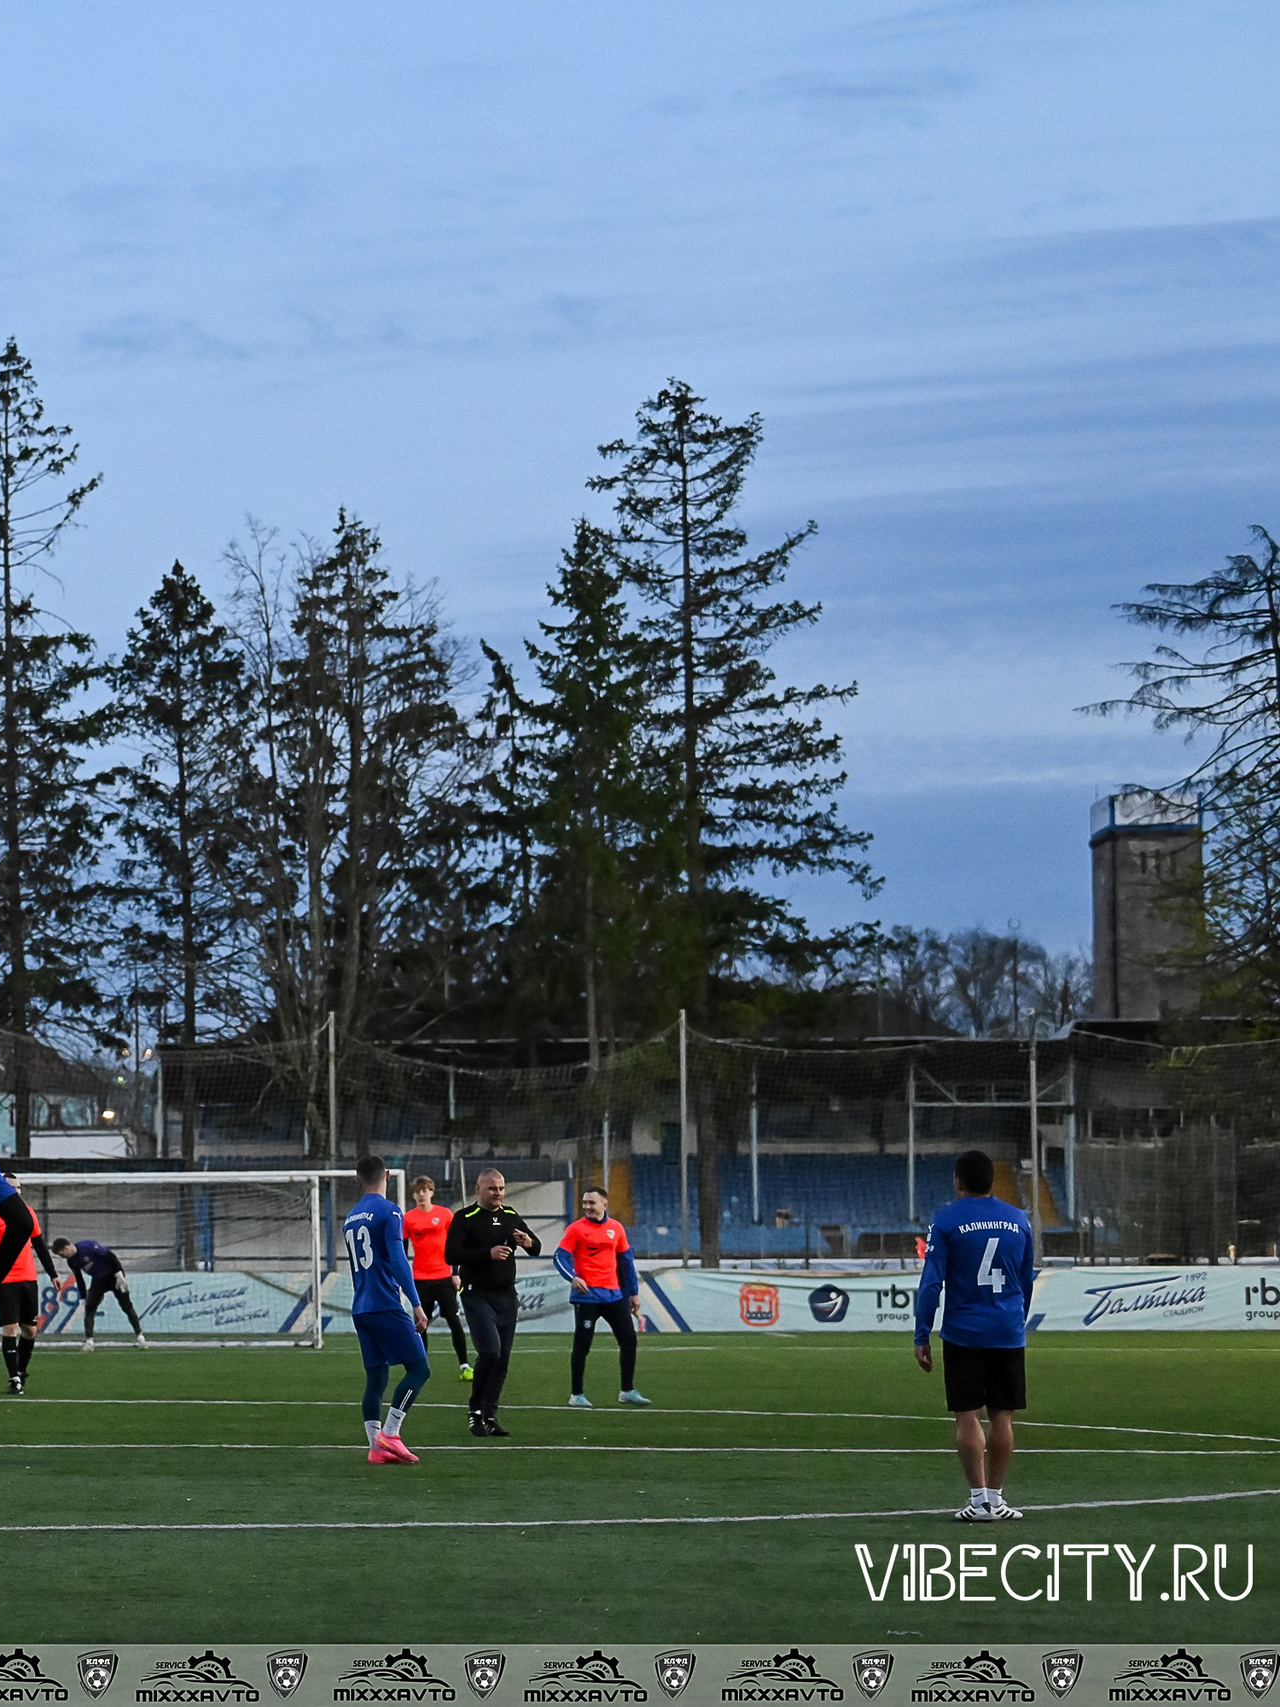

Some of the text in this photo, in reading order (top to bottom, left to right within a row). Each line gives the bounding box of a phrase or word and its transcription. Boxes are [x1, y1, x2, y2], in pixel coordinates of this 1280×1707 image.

[959, 1221, 1019, 1234] КАЛИНИНГРАД
[345, 1225, 374, 1272] 13
[977, 1237, 1006, 1293] 4
[1185, 1272, 1207, 1282] 1892
[1083, 1275, 1206, 1327] Балтика
[876, 1313, 910, 1323] group
[1163, 1305, 1205, 1318] СТАДИОН
